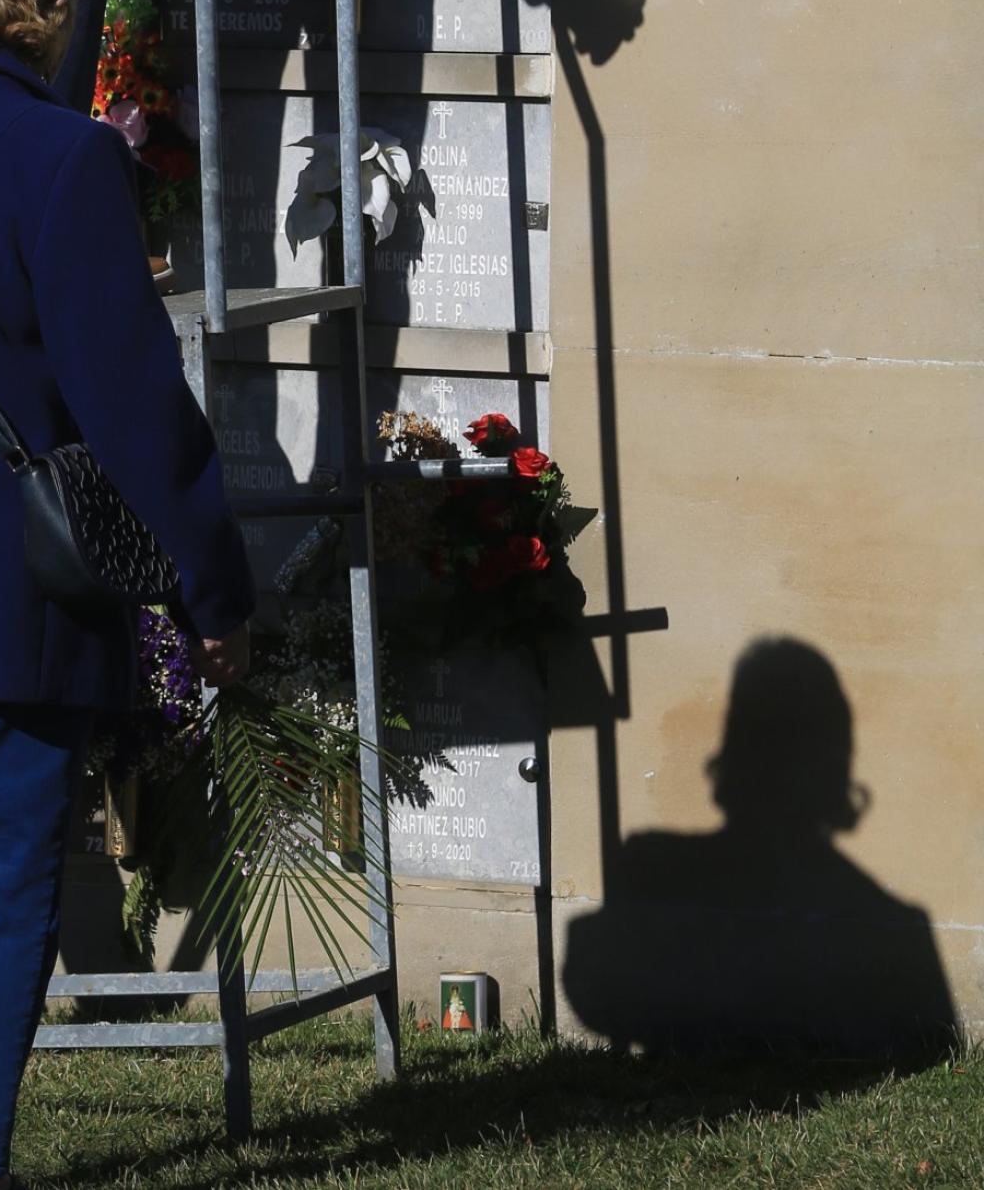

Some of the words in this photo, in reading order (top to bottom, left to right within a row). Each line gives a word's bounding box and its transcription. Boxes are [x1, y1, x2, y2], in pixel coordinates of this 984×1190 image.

[431, 175, 508, 198] FERNANDEZ
[455, 204, 483, 220] 1999
[449, 255, 508, 276] IGLESIAS
[411, 279, 425, 295] 28
[453, 281, 480, 298] 2015
[391, 814, 448, 836] MARTINEZ
[453, 818, 487, 838] RUBIO
[446, 844, 471, 861] 2020
